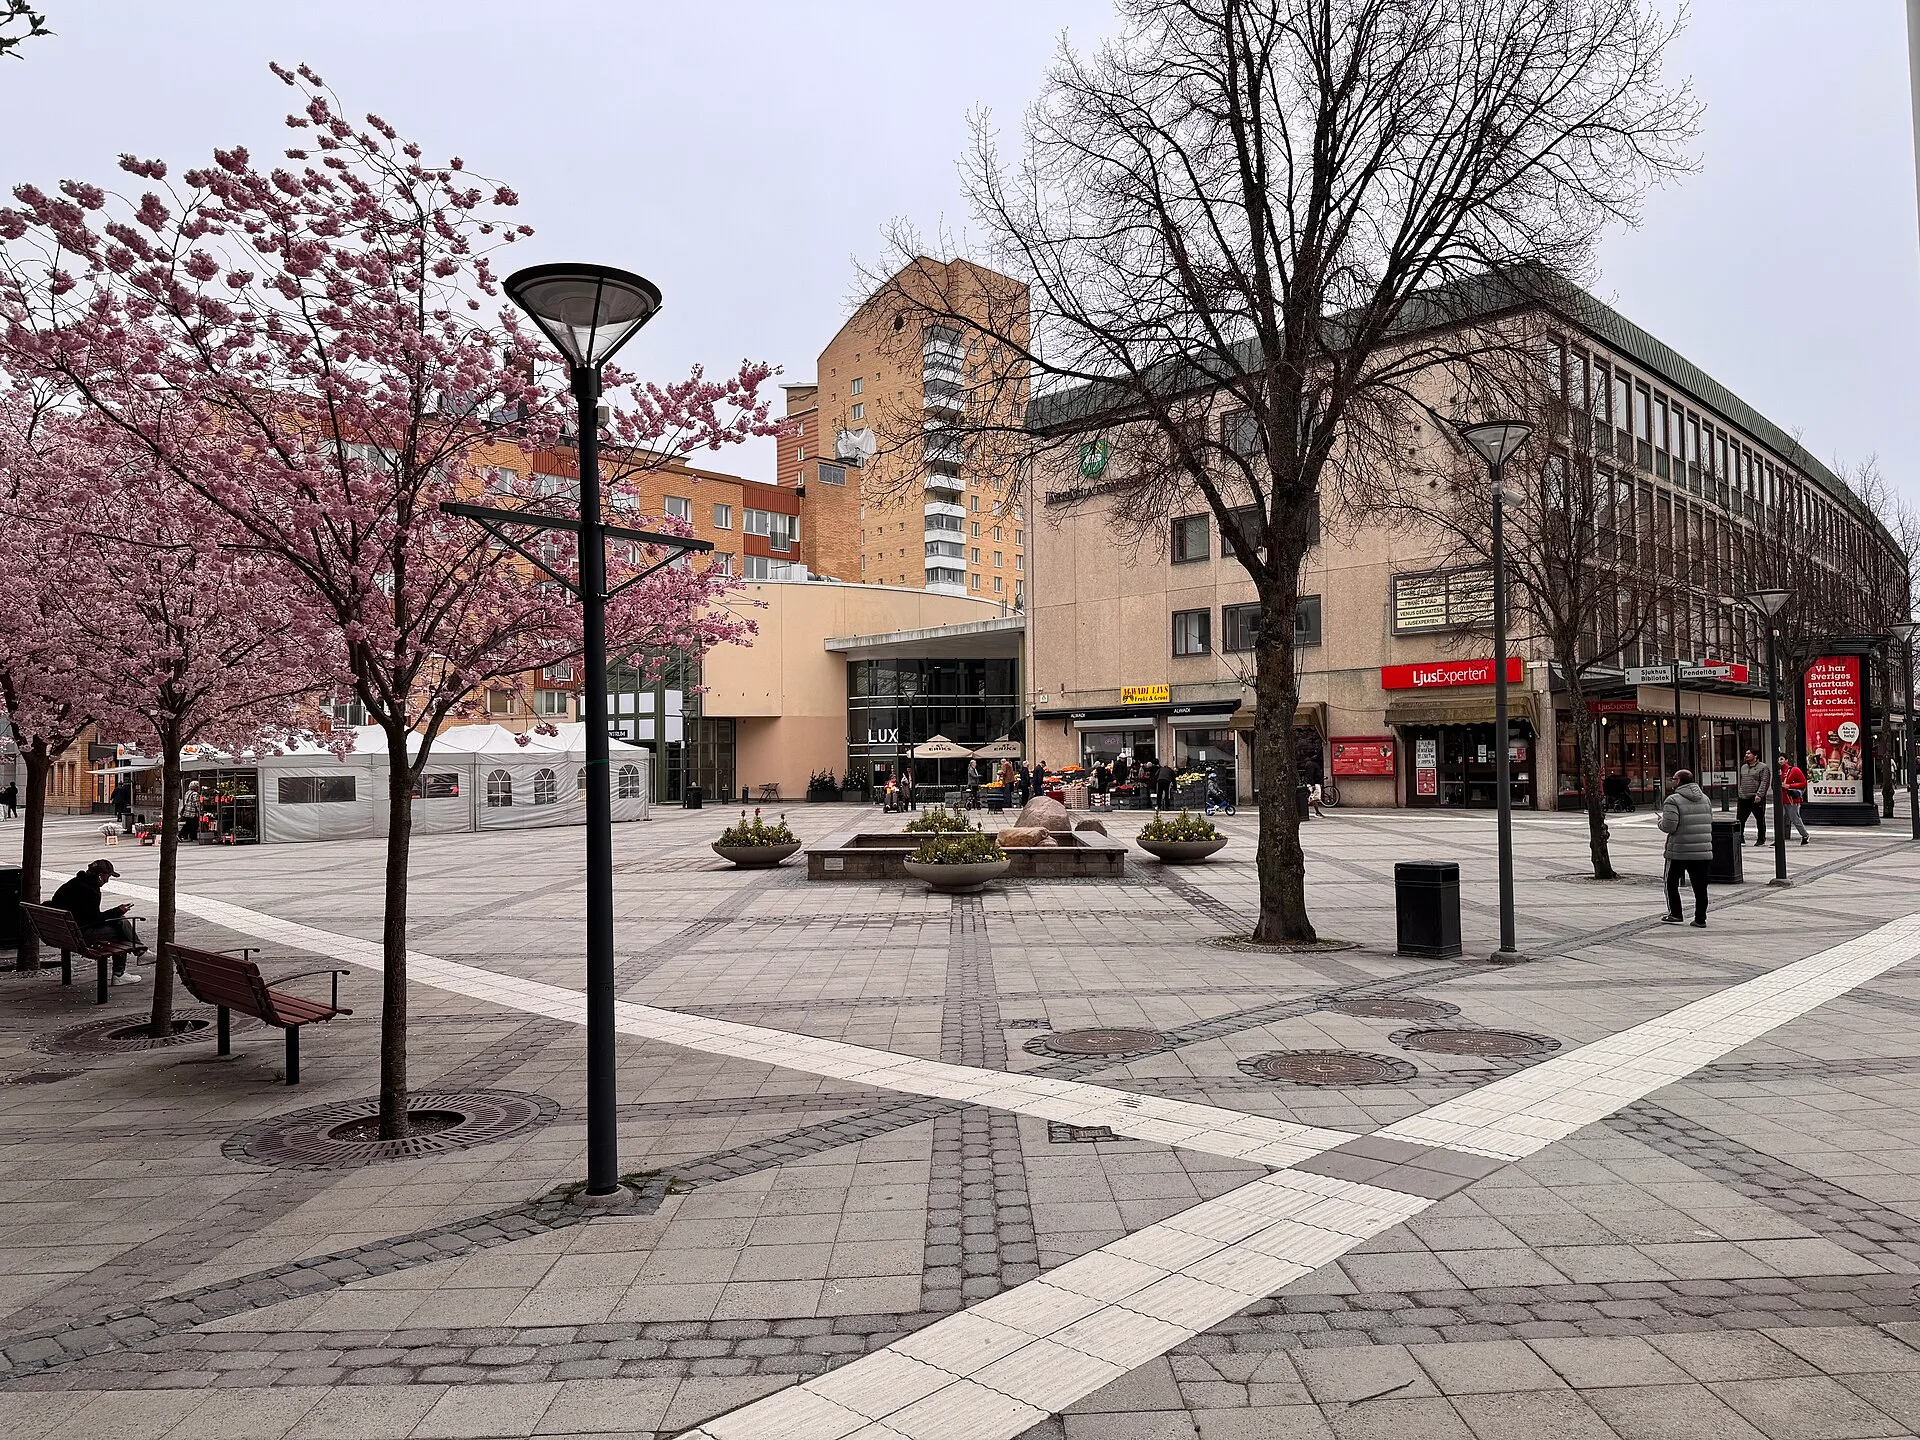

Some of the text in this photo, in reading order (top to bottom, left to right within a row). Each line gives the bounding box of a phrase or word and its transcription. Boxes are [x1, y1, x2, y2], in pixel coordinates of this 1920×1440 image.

[1404, 618, 1439, 626] LJUSEXPERTEN
[1683, 668, 1717, 676] Pendeltåg
[1413, 667, 1487, 686] LjusExperten
[1811, 672, 1851, 681] Sveriges
[1152, 686, 1169, 694] LIVS
[1812, 688, 1849, 696] kunder.
[1807, 697, 1856, 706] I år också.
[1598, 703, 1636, 711] LjusExperten
[868, 728, 898, 743] LUX
[1813, 786, 1856, 795] WiLLY:S
